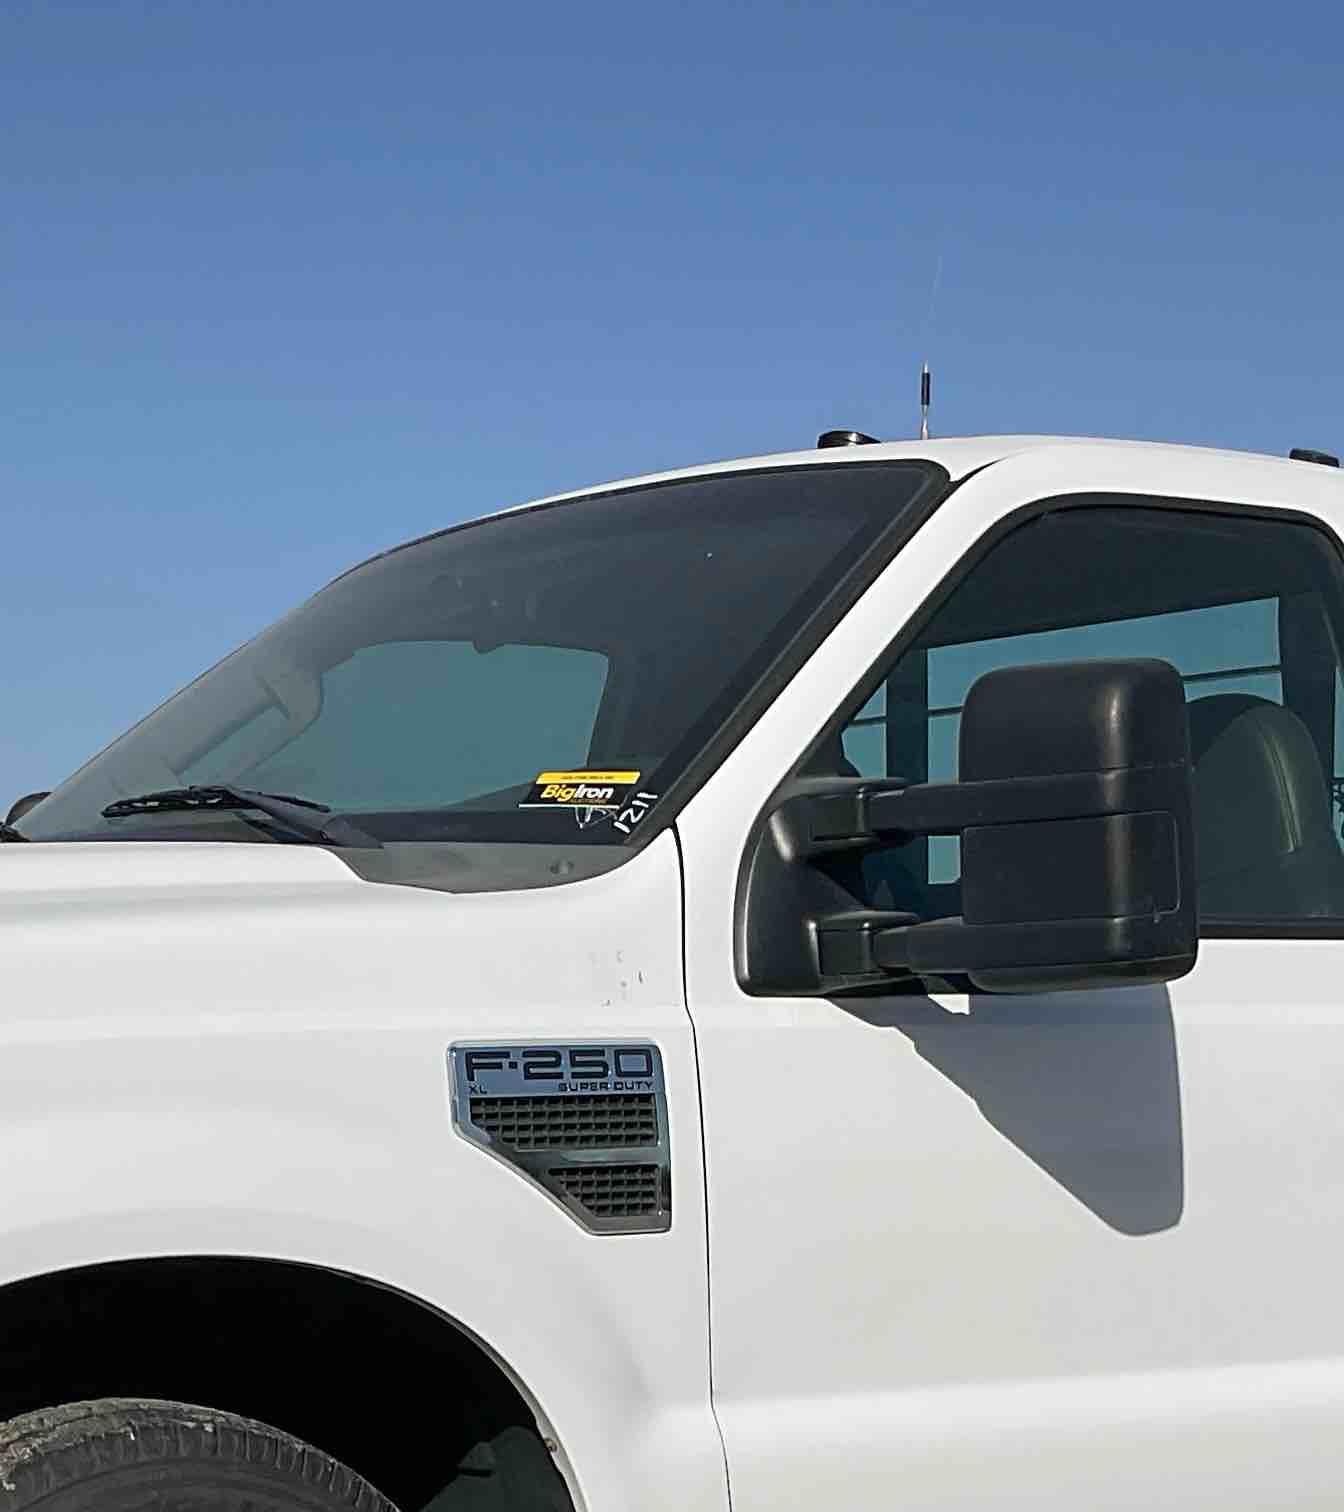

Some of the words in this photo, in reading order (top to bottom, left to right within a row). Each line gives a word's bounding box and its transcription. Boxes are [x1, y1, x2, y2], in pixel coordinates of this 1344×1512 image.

[539, 783, 614, 802] BigIron
[464, 1048, 654, 1081] F-250
[468, 1085, 488, 1095] XL
[558, 1081, 610, 1093] SUPER
[613, 1080, 654, 1092] DUTY
